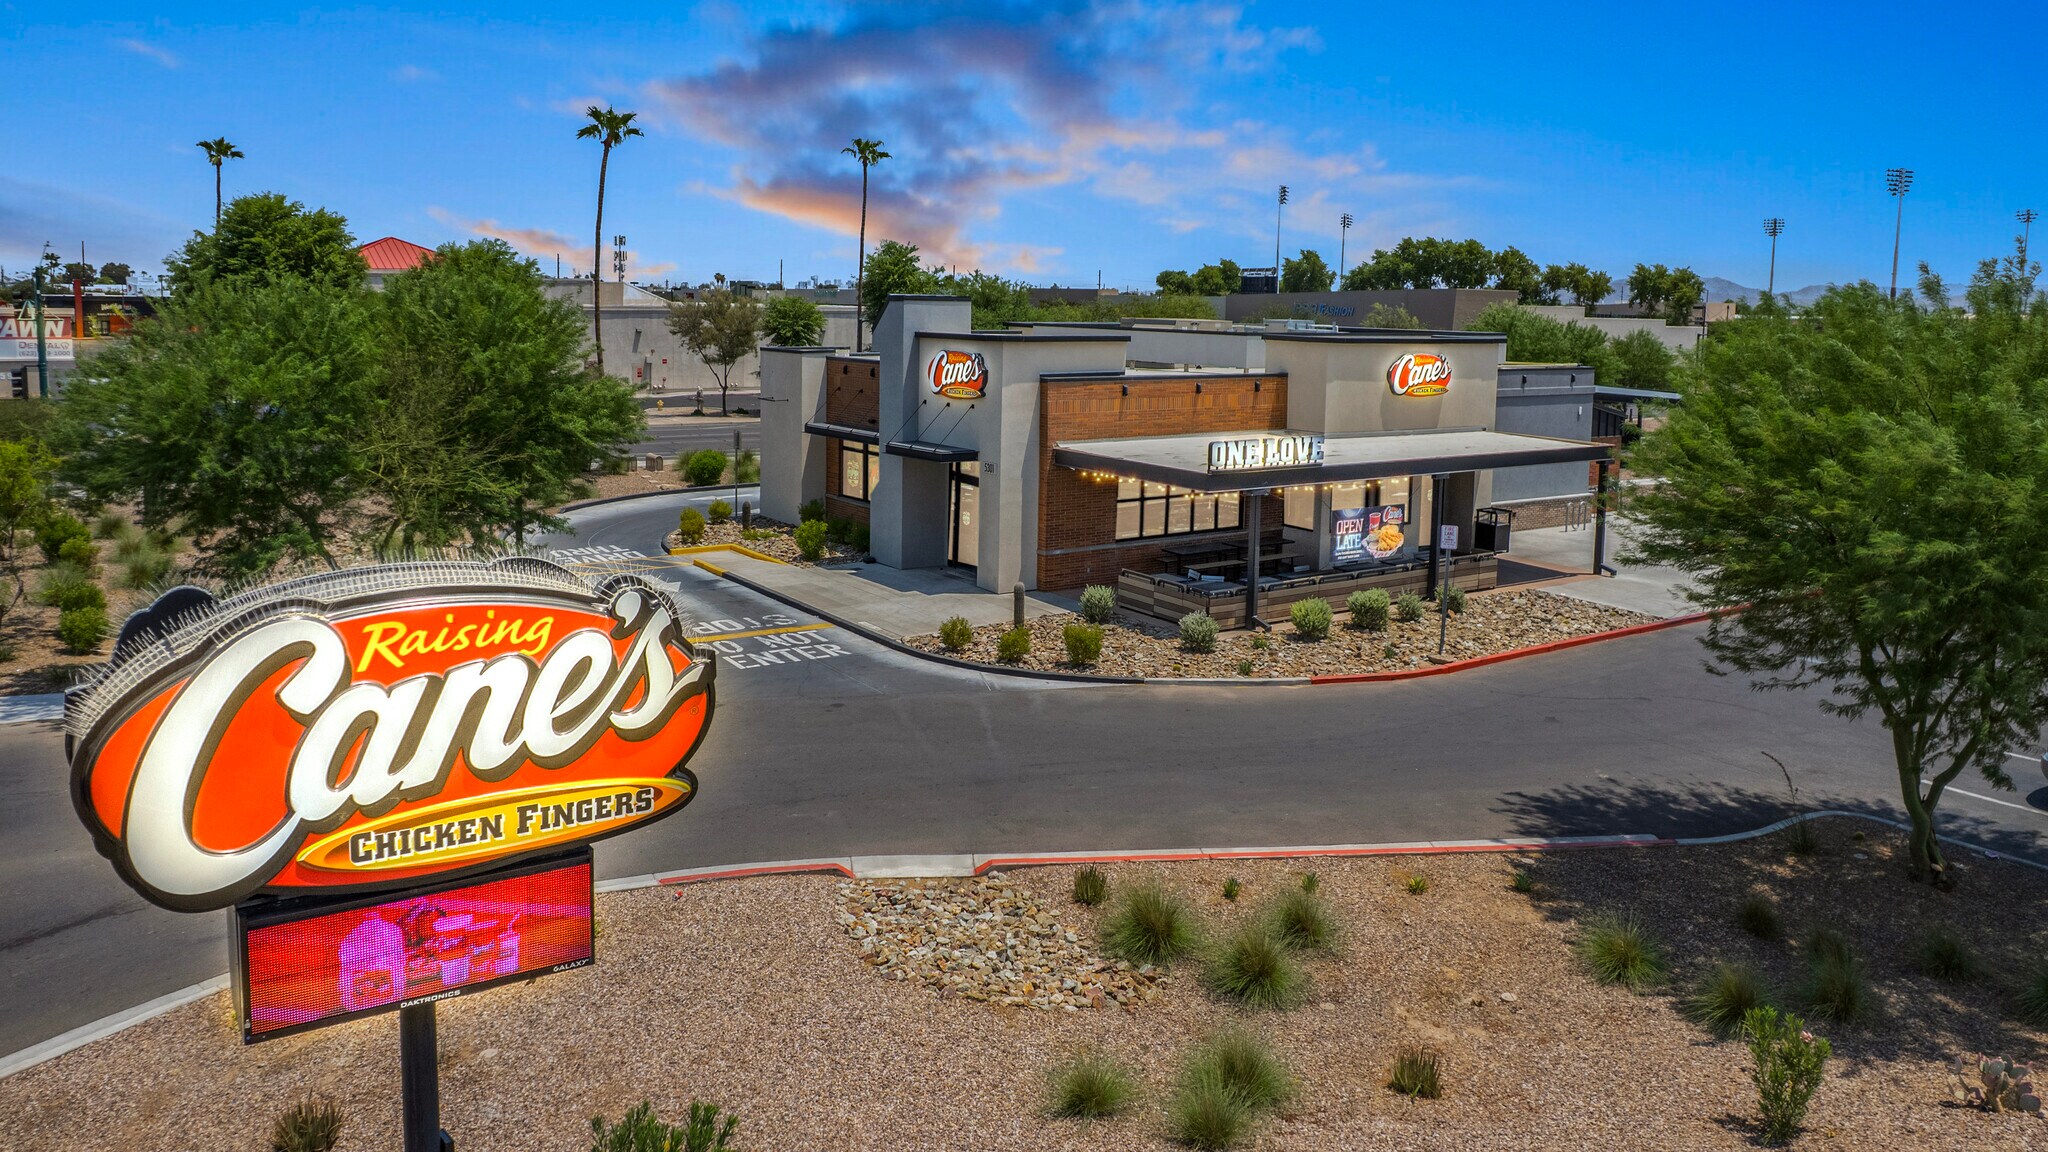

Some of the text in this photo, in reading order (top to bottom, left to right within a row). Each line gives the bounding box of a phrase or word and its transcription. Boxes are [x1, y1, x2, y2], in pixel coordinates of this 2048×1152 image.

[0, 318, 64, 337] AWN
[930, 350, 981, 393] Cane's
[1394, 354, 1452, 394] Cane's
[1208, 436, 1325, 467] ONE LOVE
[1336, 518, 1364, 535] OPEN
[1336, 533, 1362, 550] LATE
[692, 614, 797, 634] STOP
[356, 609, 554, 673] Raising
[753, 630, 829, 648] NOT
[722, 644, 852, 669] ENTER
[126, 590, 706, 895] Cane's
[350, 787, 655, 866] CHICKEN FINGERS
[553, 959, 588, 972] GALAXY
[401, 989, 461, 1009] DAKTRONICS
